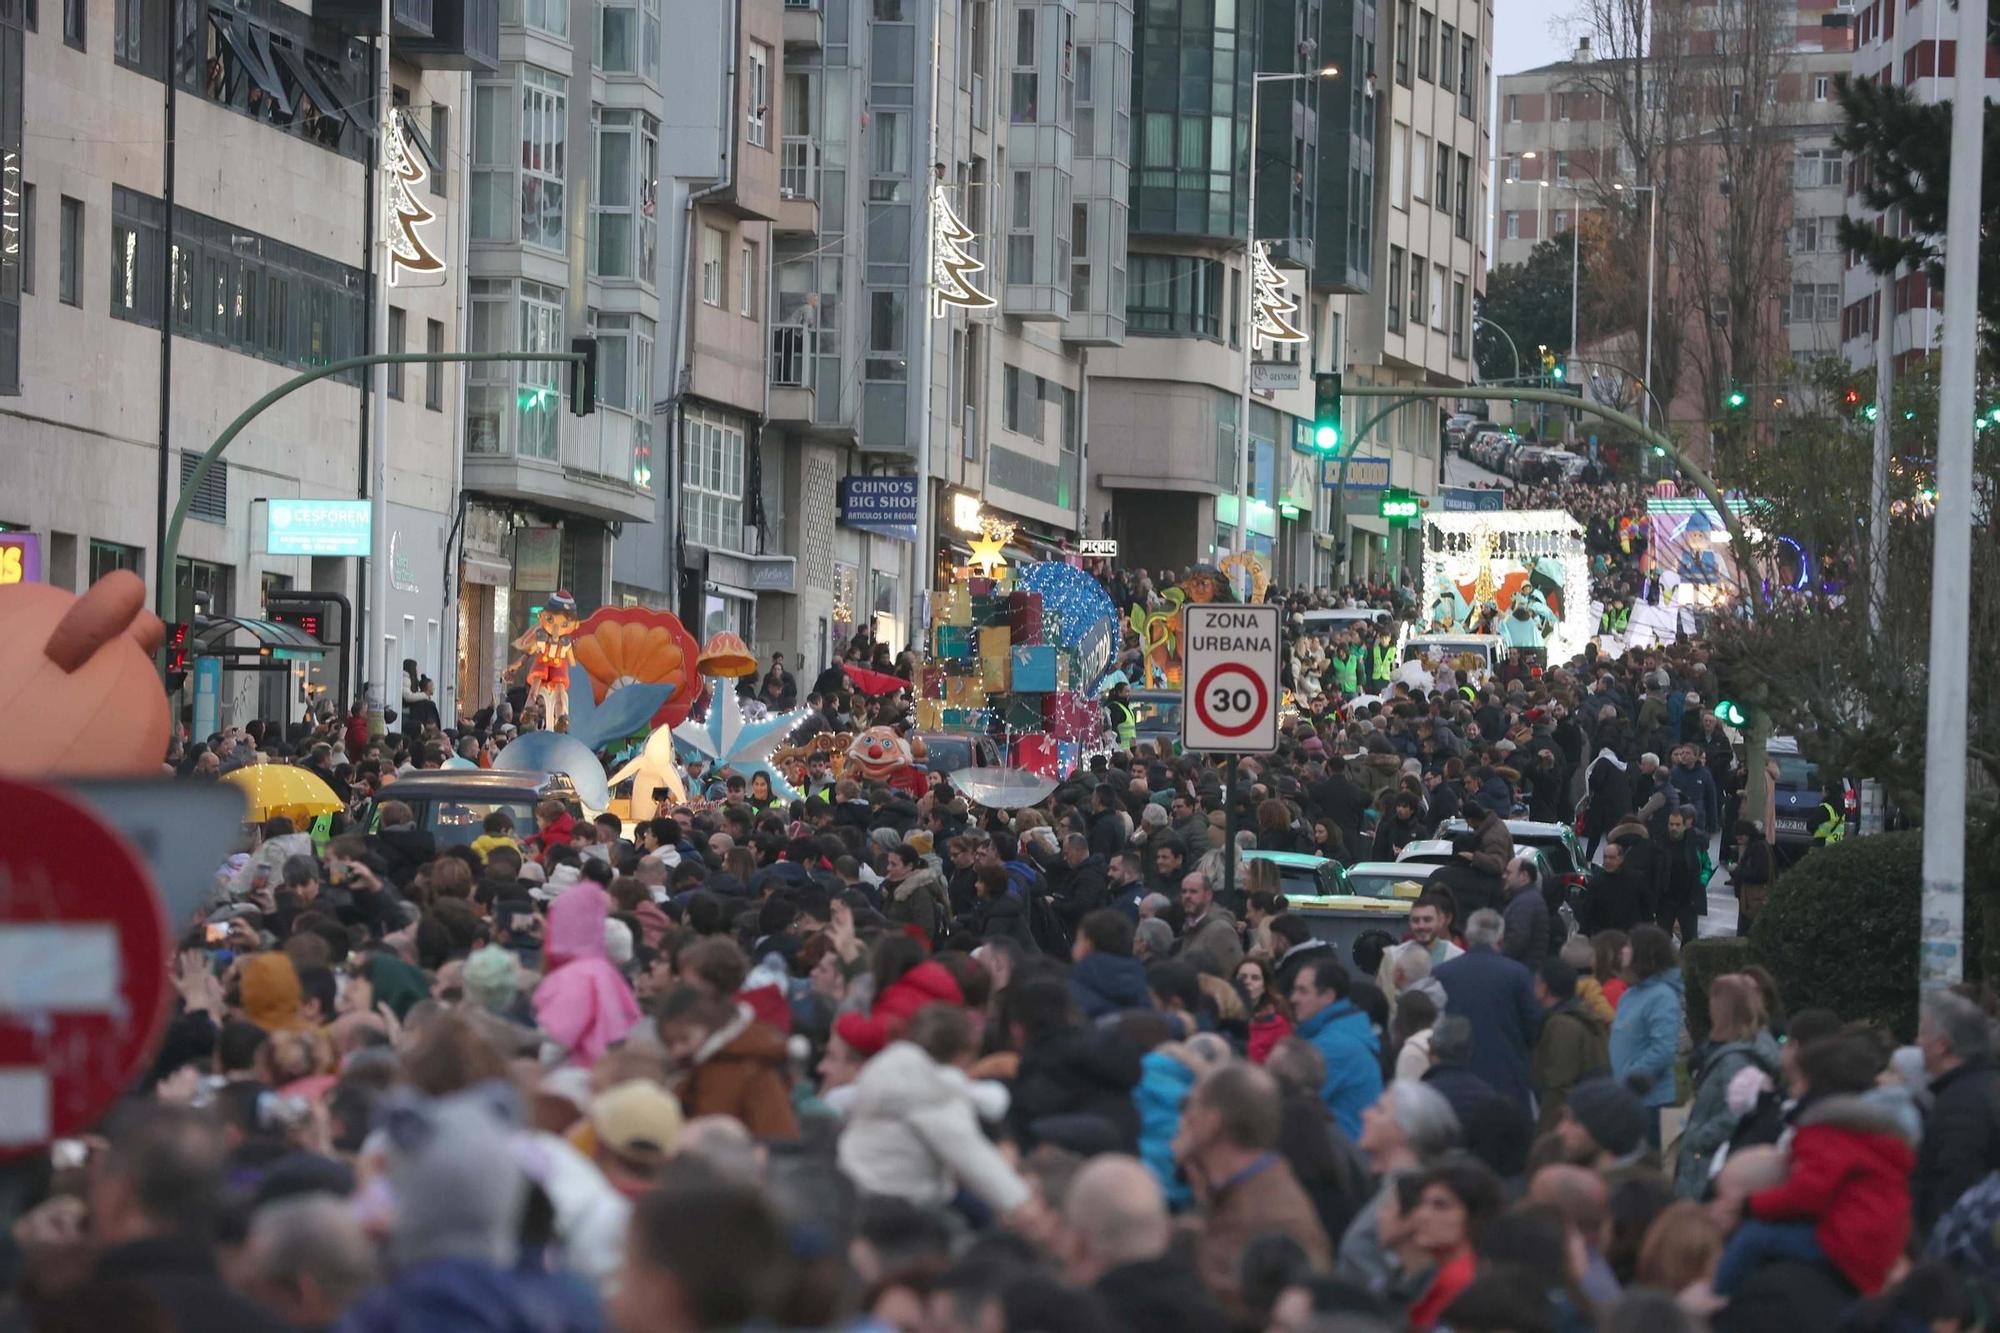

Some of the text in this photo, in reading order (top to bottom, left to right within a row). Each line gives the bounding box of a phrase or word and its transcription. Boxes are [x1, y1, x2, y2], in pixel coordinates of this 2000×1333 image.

[1270, 373, 1297, 381] GESTORIA
[851, 481, 913, 494] CHINO'S
[849, 496, 919, 509] BIG SHOP
[294, 507, 369, 523] CESFOREM
[848, 512, 882, 520] ARTICULOS
[884, 512, 893, 520] DE
[1082, 542, 1115, 554] PICNIC
[1206, 613, 1259, 629] ZONA
[1193, 636, 1272, 652] URBANA
[1213, 688, 1251, 712] 30
